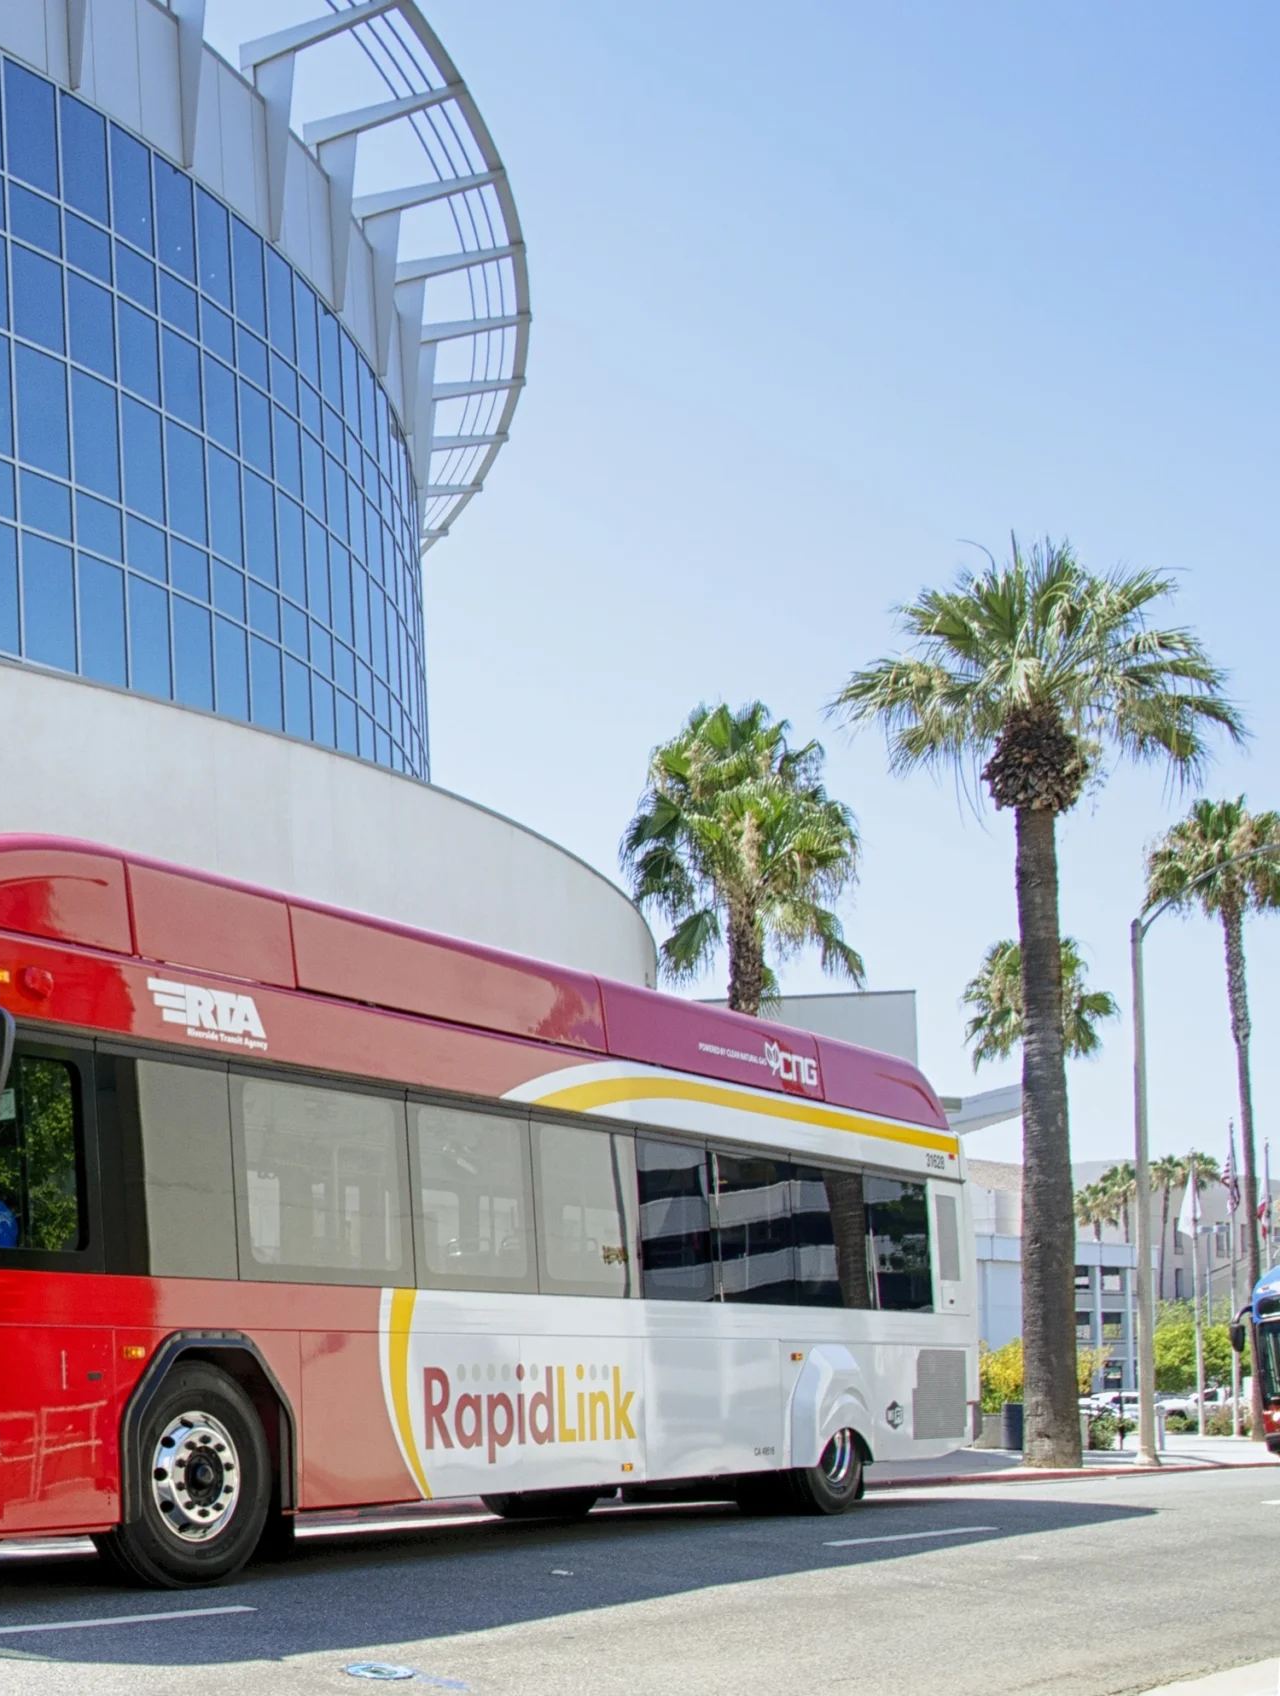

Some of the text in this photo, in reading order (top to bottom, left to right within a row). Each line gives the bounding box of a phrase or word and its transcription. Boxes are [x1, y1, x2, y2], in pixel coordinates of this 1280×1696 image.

[185, 984, 267, 1039] RTA
[186, 1026, 268, 1052] Riverside Transit Agency
[423, 1363, 636, 1464] RapidLink
